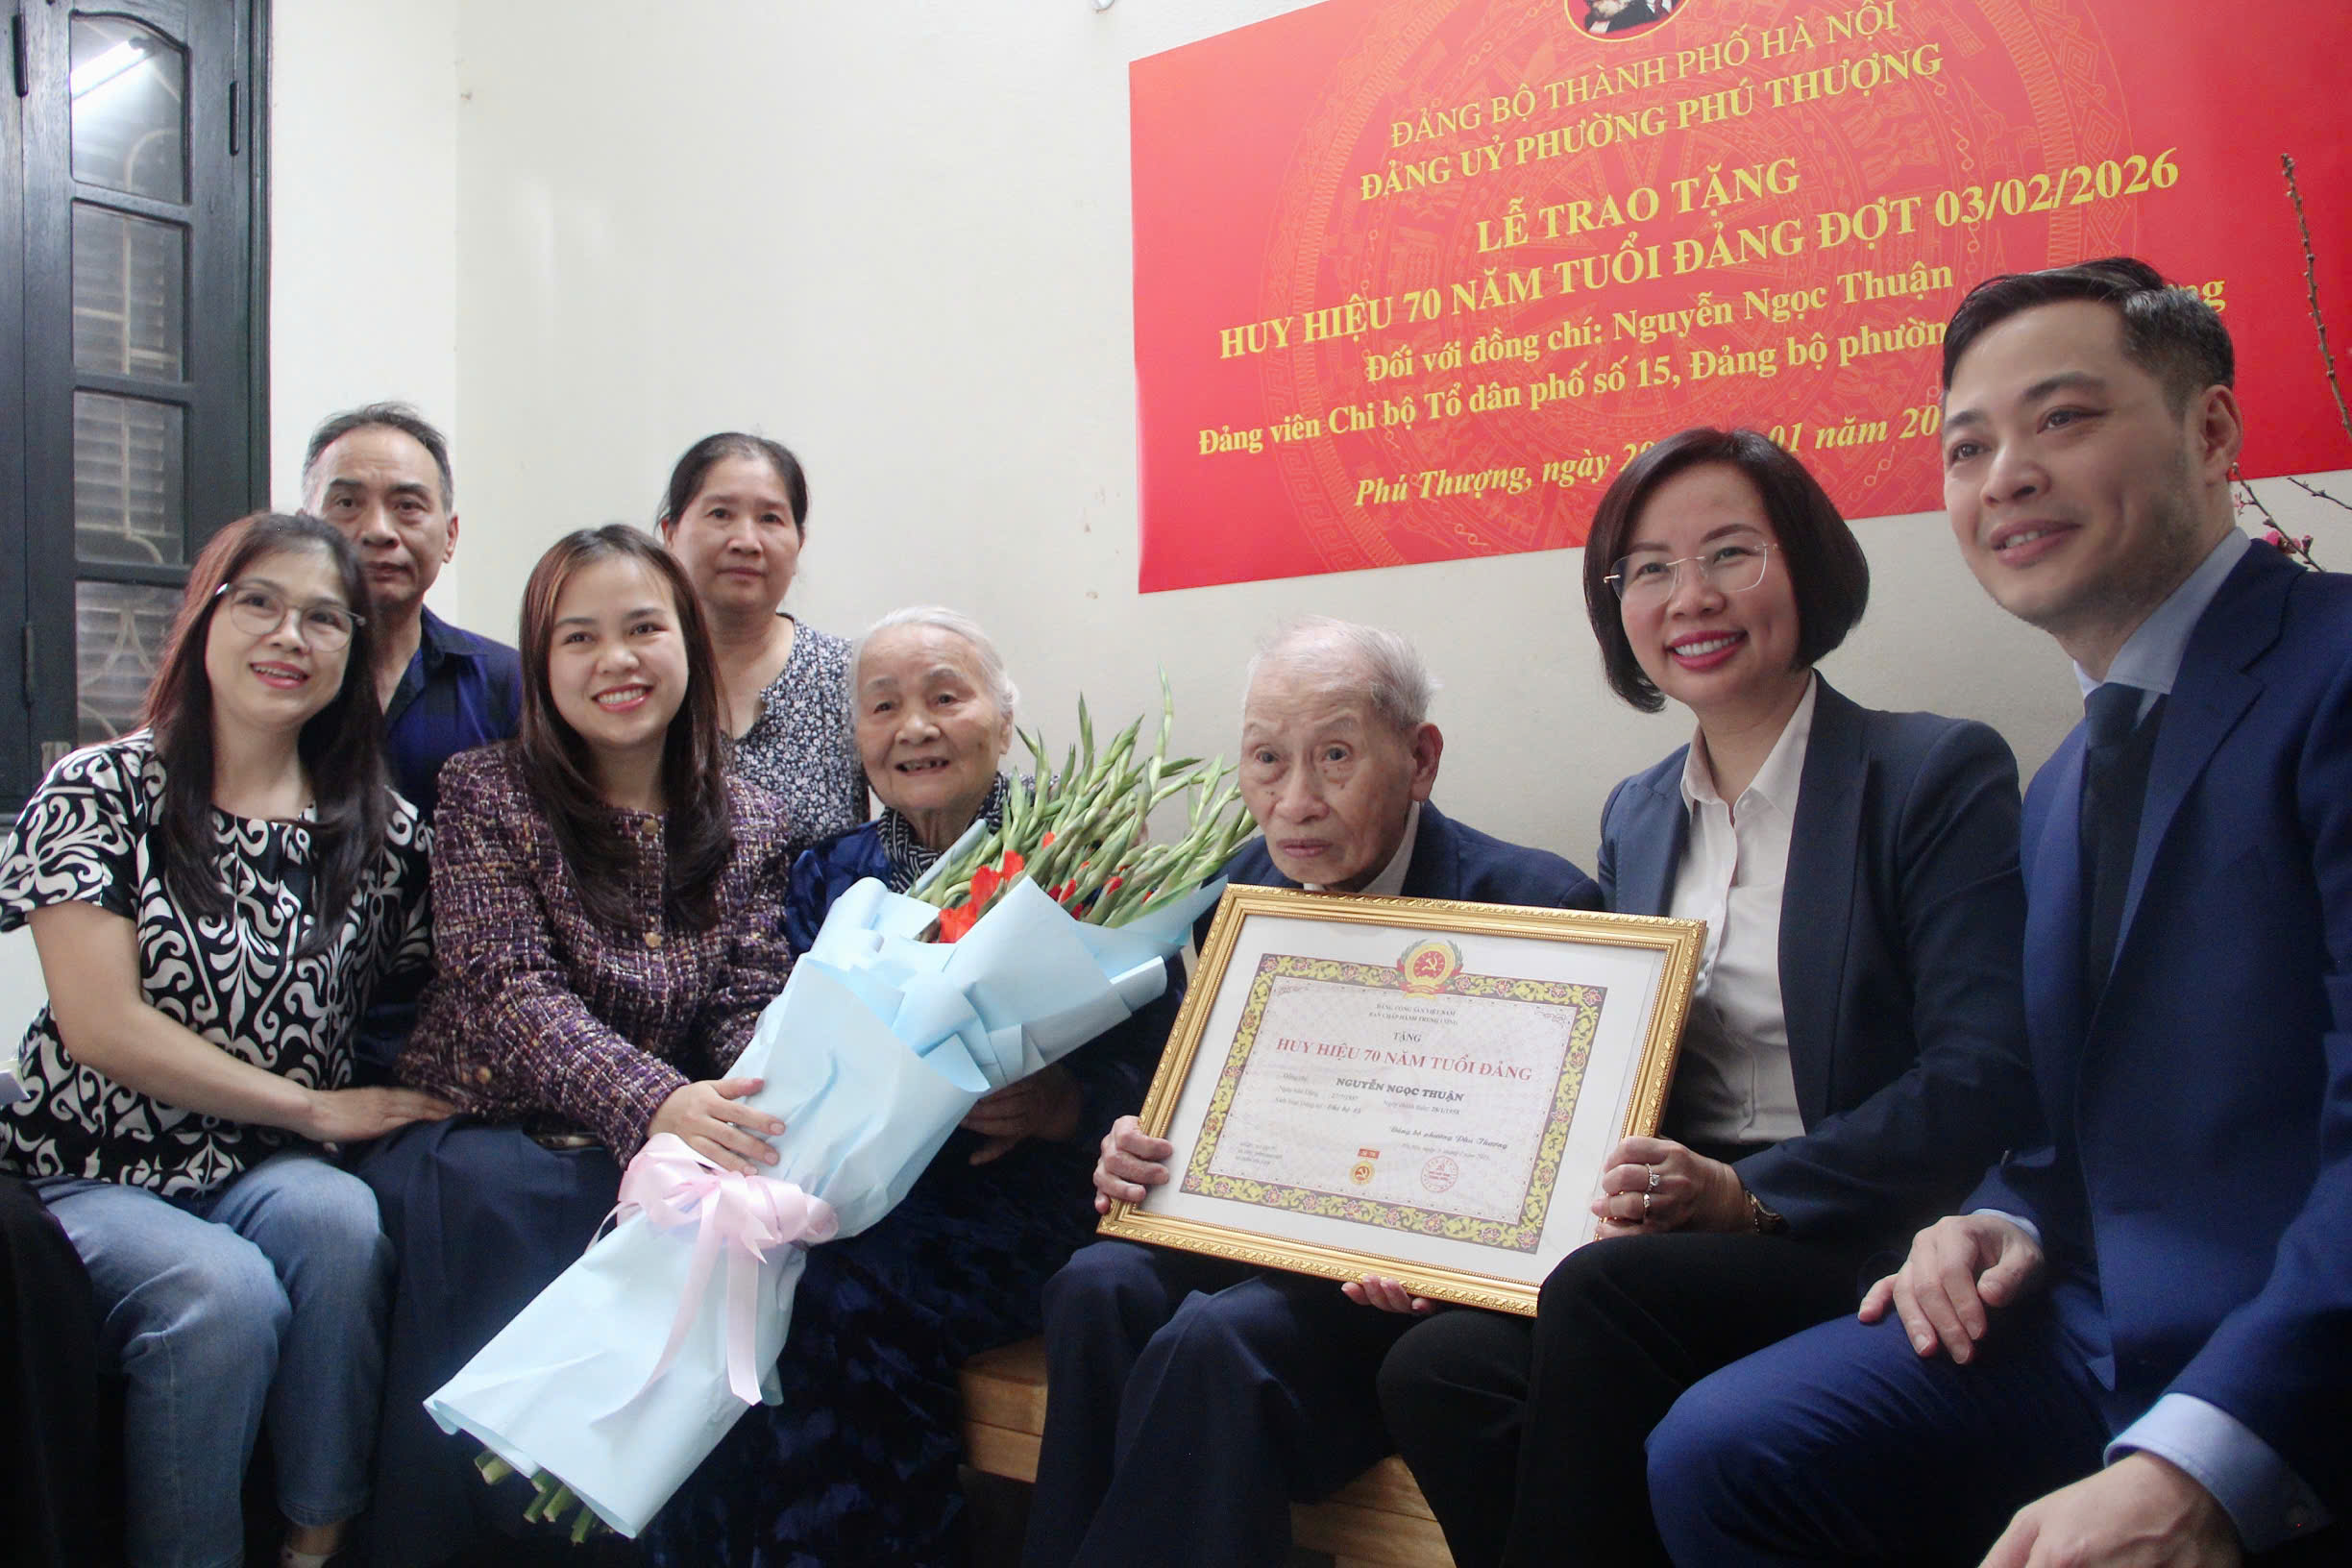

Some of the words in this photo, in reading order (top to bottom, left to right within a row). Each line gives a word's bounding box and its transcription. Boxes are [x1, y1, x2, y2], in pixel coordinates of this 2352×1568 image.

[1360, 157, 1453, 201] ĐẢNG
[1459, 134, 1507, 178] UỶ
[1514, 110, 1669, 166] PHƯỜNG
[1676, 76, 1754, 130] PHÚ
[1764, 44, 1944, 109] THƯỢNG
[1391, 103, 1482, 147] ĐẢNG
[1491, 83, 1537, 123] BỘ
[1543, 56, 1668, 110] THÀNH
[1676, 23, 1752, 79] PHỐ
[1760, 15, 1815, 59] HÀ
[1825, 0, 1899, 44] NỘI
[1220, 317, 1291, 358] HUY
[1303, 293, 1392, 343] HIỆU
[1403, 288, 1441, 323] 70
[1450, 268, 1544, 315] NĂM
[1553, 231, 1660, 294] TUỔI
[1673, 220, 1804, 274] ĐẢNG
[1818, 196, 1922, 250] ĐỢT
[1935, 148, 2178, 227] 03/02/2026
[1479, 197, 1530, 254] LỄ
[1539, 187, 1660, 239] TRAO
[1671, 158, 1799, 215] TẶNG
[1365, 346, 1414, 382] Đối
[1423, 340, 1461, 371] với
[1470, 326, 1540, 364] đồng
[1548, 316, 1603, 351] chí:
[1614, 292, 1733, 344] Nguyễn
[1743, 287, 1827, 323] Ngọc
[1837, 261, 1952, 303] Thuận
[1200, 425, 1263, 453] Đảng
[1270, 415, 1322, 443] viên
[1329, 403, 1376, 433] Chi
[1384, 396, 1417, 433] bộ
[1423, 382, 1462, 419] Tổ
[1469, 382, 1521, 413] dân
[1530, 361, 1588, 411] phố
[1593, 355, 1629, 394] số
[1639, 355, 1680, 387] 15,
[1691, 346, 1777, 380] Đảng
[1786, 332, 1827, 369] bộ
[1839, 318, 1947, 366] phườn
[1356, 475, 1408, 507] Phú
[1419, 468, 1531, 499] Thượng,
[1543, 450, 1610, 487] ngày
[1769, 423, 1802, 452] 01
[1815, 416, 1887, 449] năm
[1899, 405, 1940, 438] 20
[1276, 1037, 1314, 1054] HUY
[1316, 1041, 1361, 1060] HIỆU
[1363, 1048, 1382, 1063] 70
[1384, 1048, 1427, 1068] NĂM
[1431, 1053, 1475, 1074] TUỔI
[1478, 1058, 1533, 1081] ĐẢNG
[1335, 1076, 1384, 1091] NGUYỄN
[1386, 1083, 1420, 1097] NGỌC
[1421, 1088, 1465, 1103] THUẬN
[1393, 1029, 1422, 1043] TẶNG
